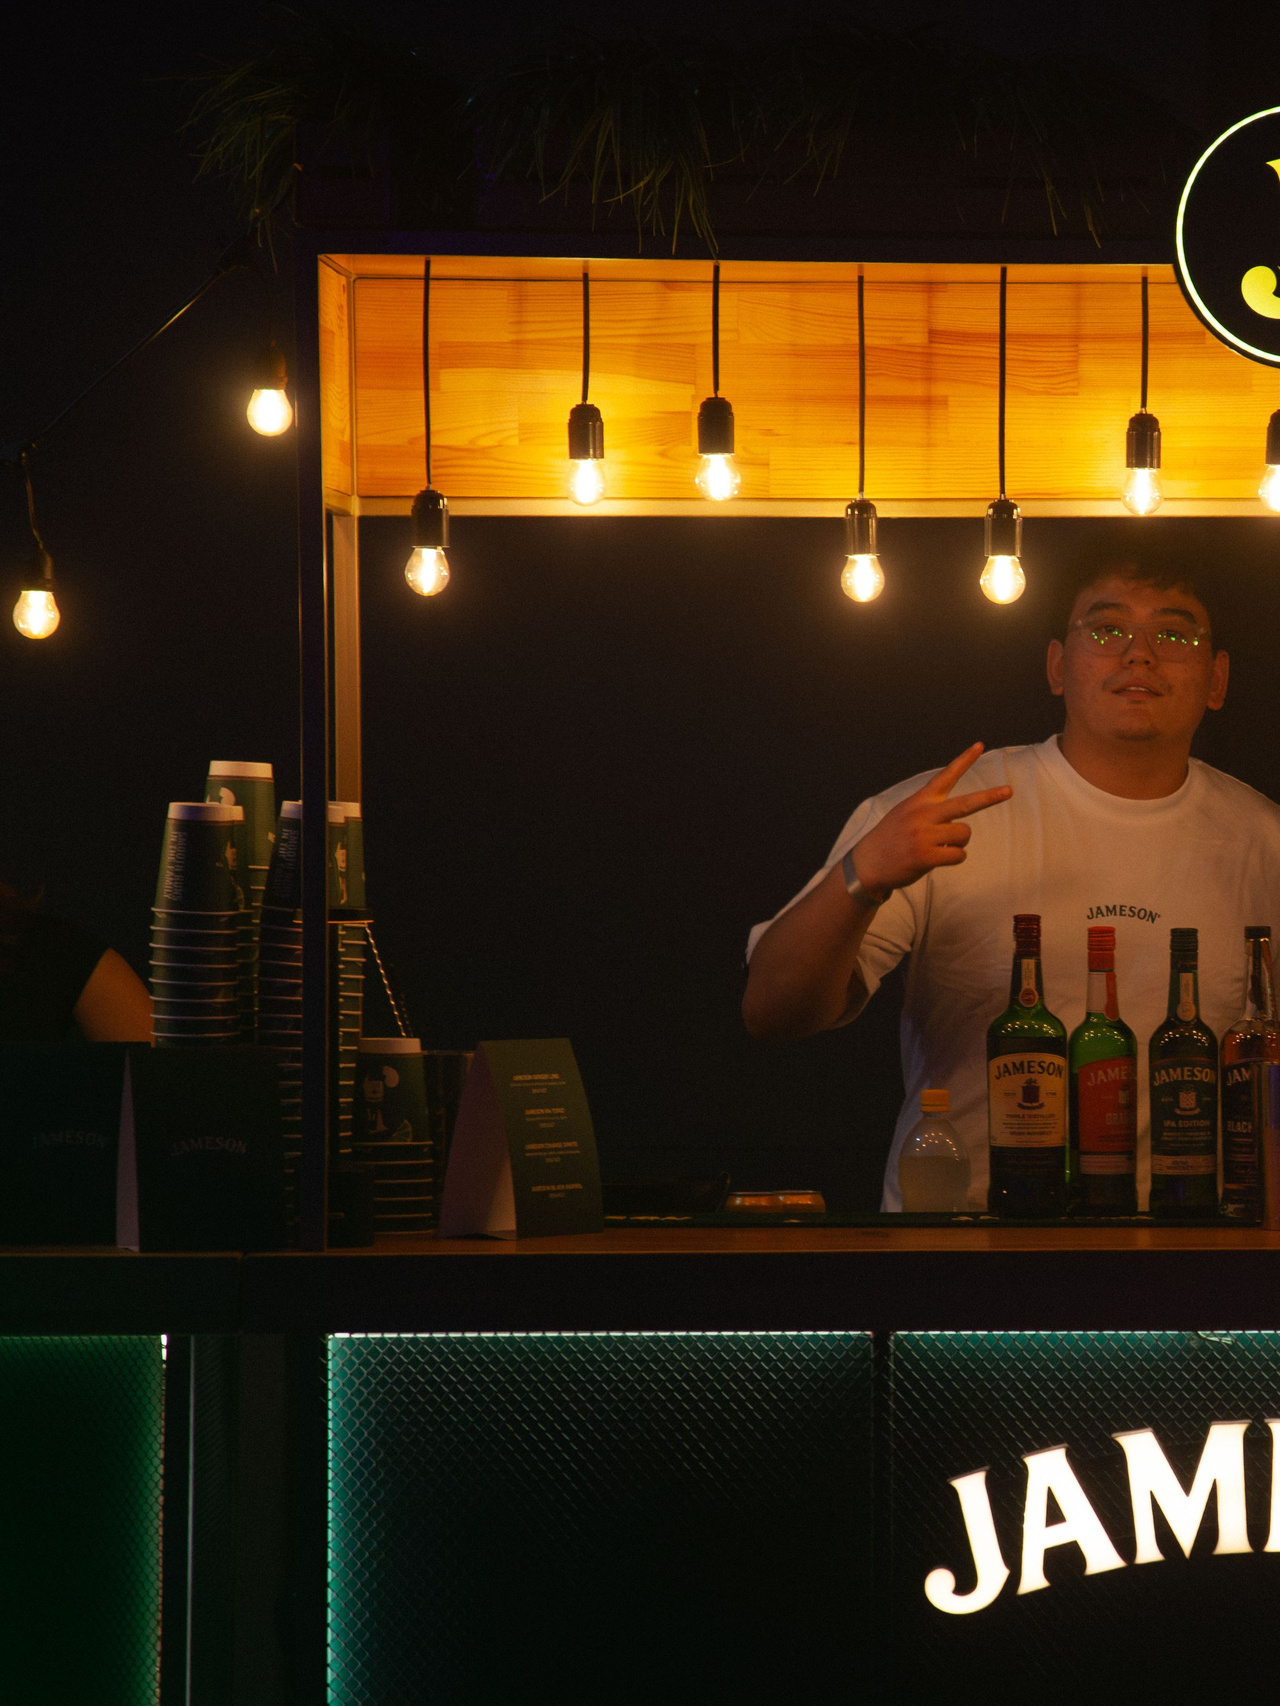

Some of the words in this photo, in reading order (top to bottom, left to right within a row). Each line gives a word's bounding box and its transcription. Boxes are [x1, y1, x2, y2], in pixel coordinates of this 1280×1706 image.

[1086, 904, 1161, 924] JAMESON
[995, 1060, 1064, 1080] JAMESON
[1087, 1065, 1136, 1087] JAME
